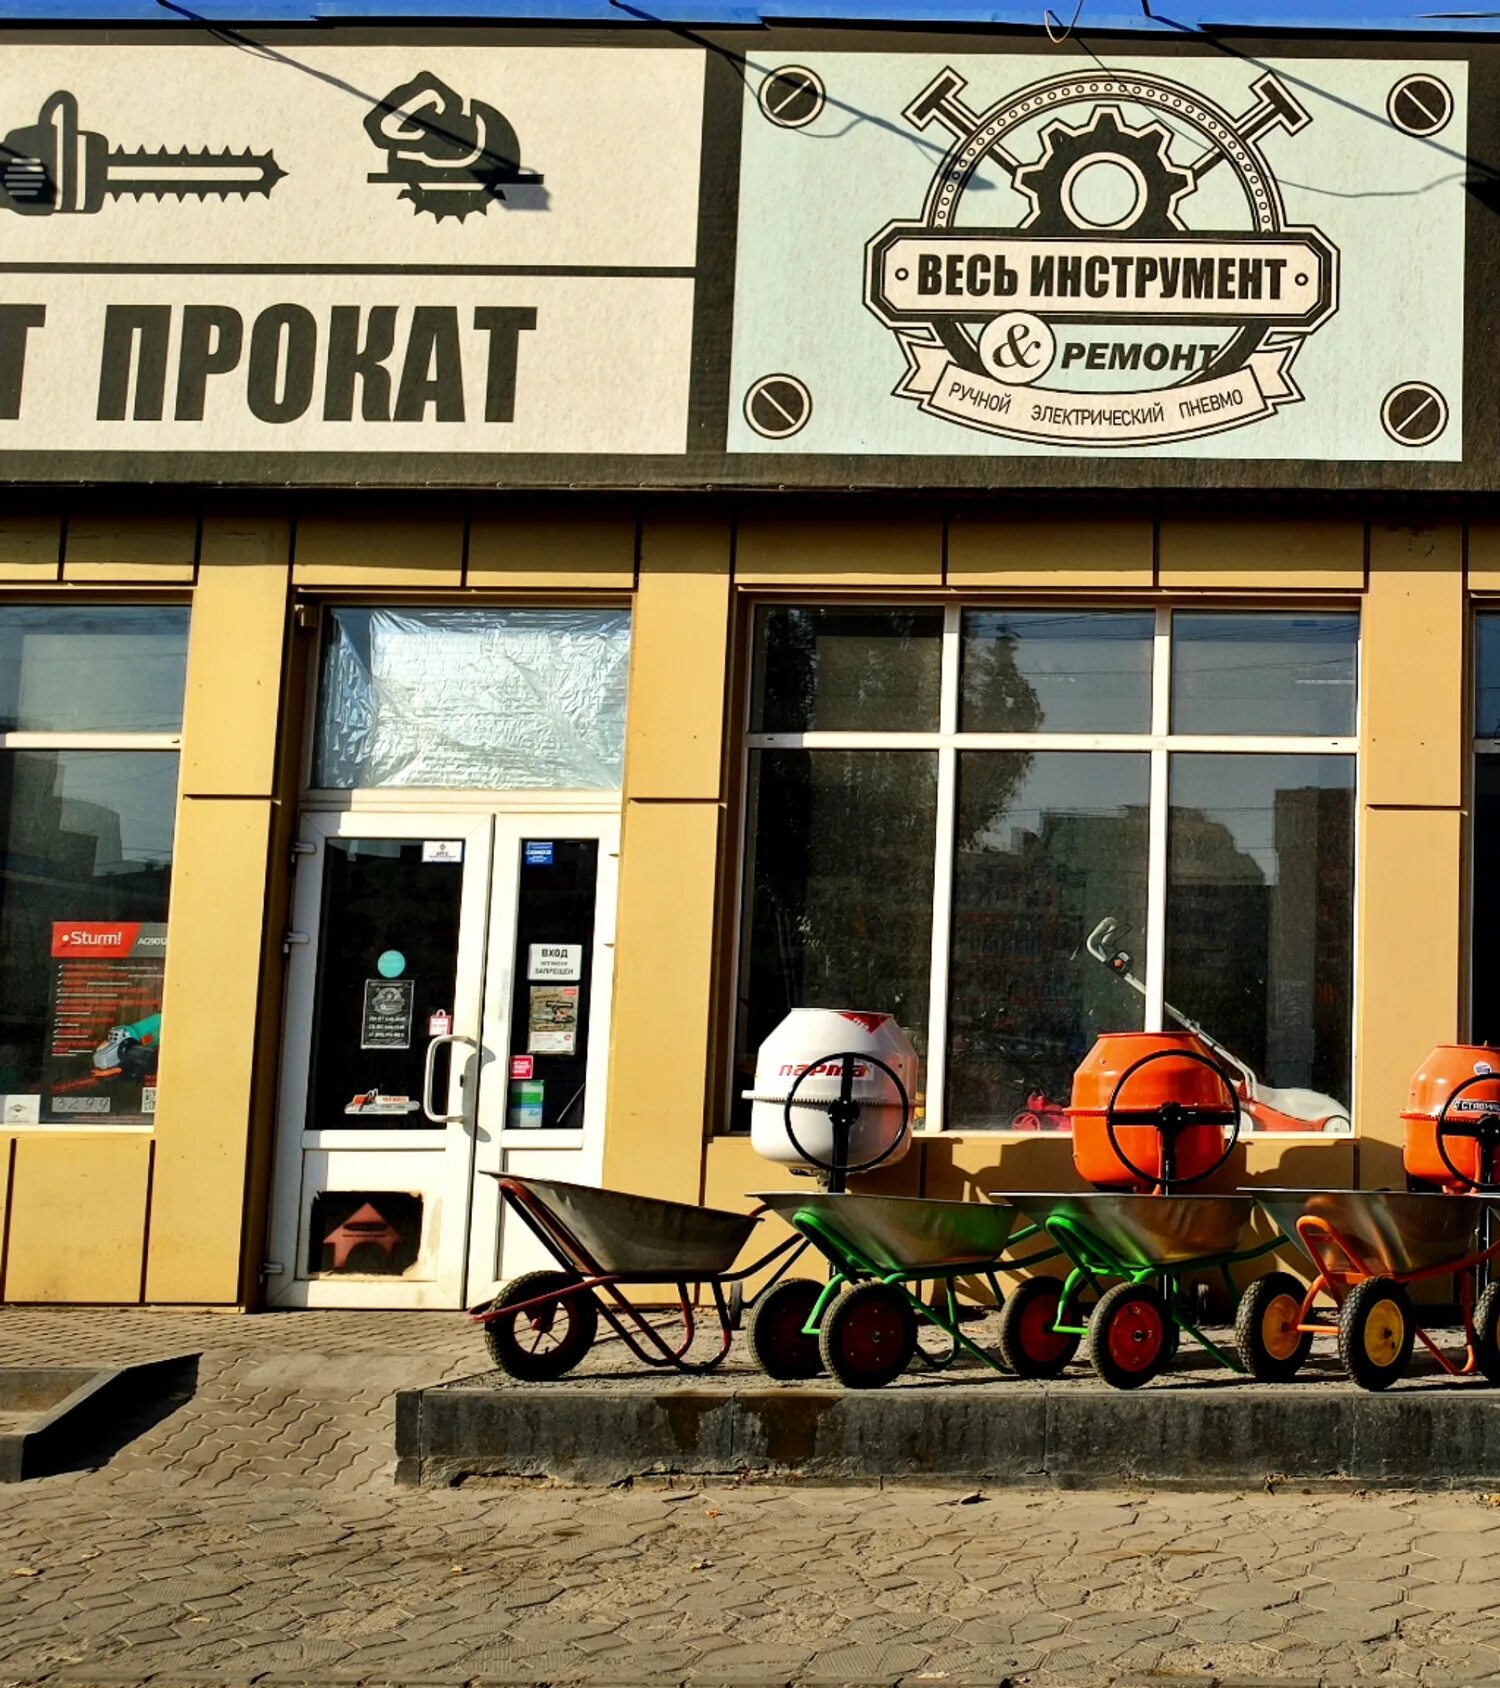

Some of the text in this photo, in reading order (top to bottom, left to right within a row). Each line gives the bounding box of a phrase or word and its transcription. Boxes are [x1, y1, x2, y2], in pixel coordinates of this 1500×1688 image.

[918, 254, 1287, 299] ВЕСЬ ИНСТРУМЕНТ
[97, 303, 537, 424] ПРОКАТ
[992, 323, 1220, 371] & РЕМОНТ
[948, 382, 1244, 426] РУЧНОЙ ЭЛЕКТРИЧЕСКИЙ ПНЕВМО
[541, 948, 568, 958] ВХОД
